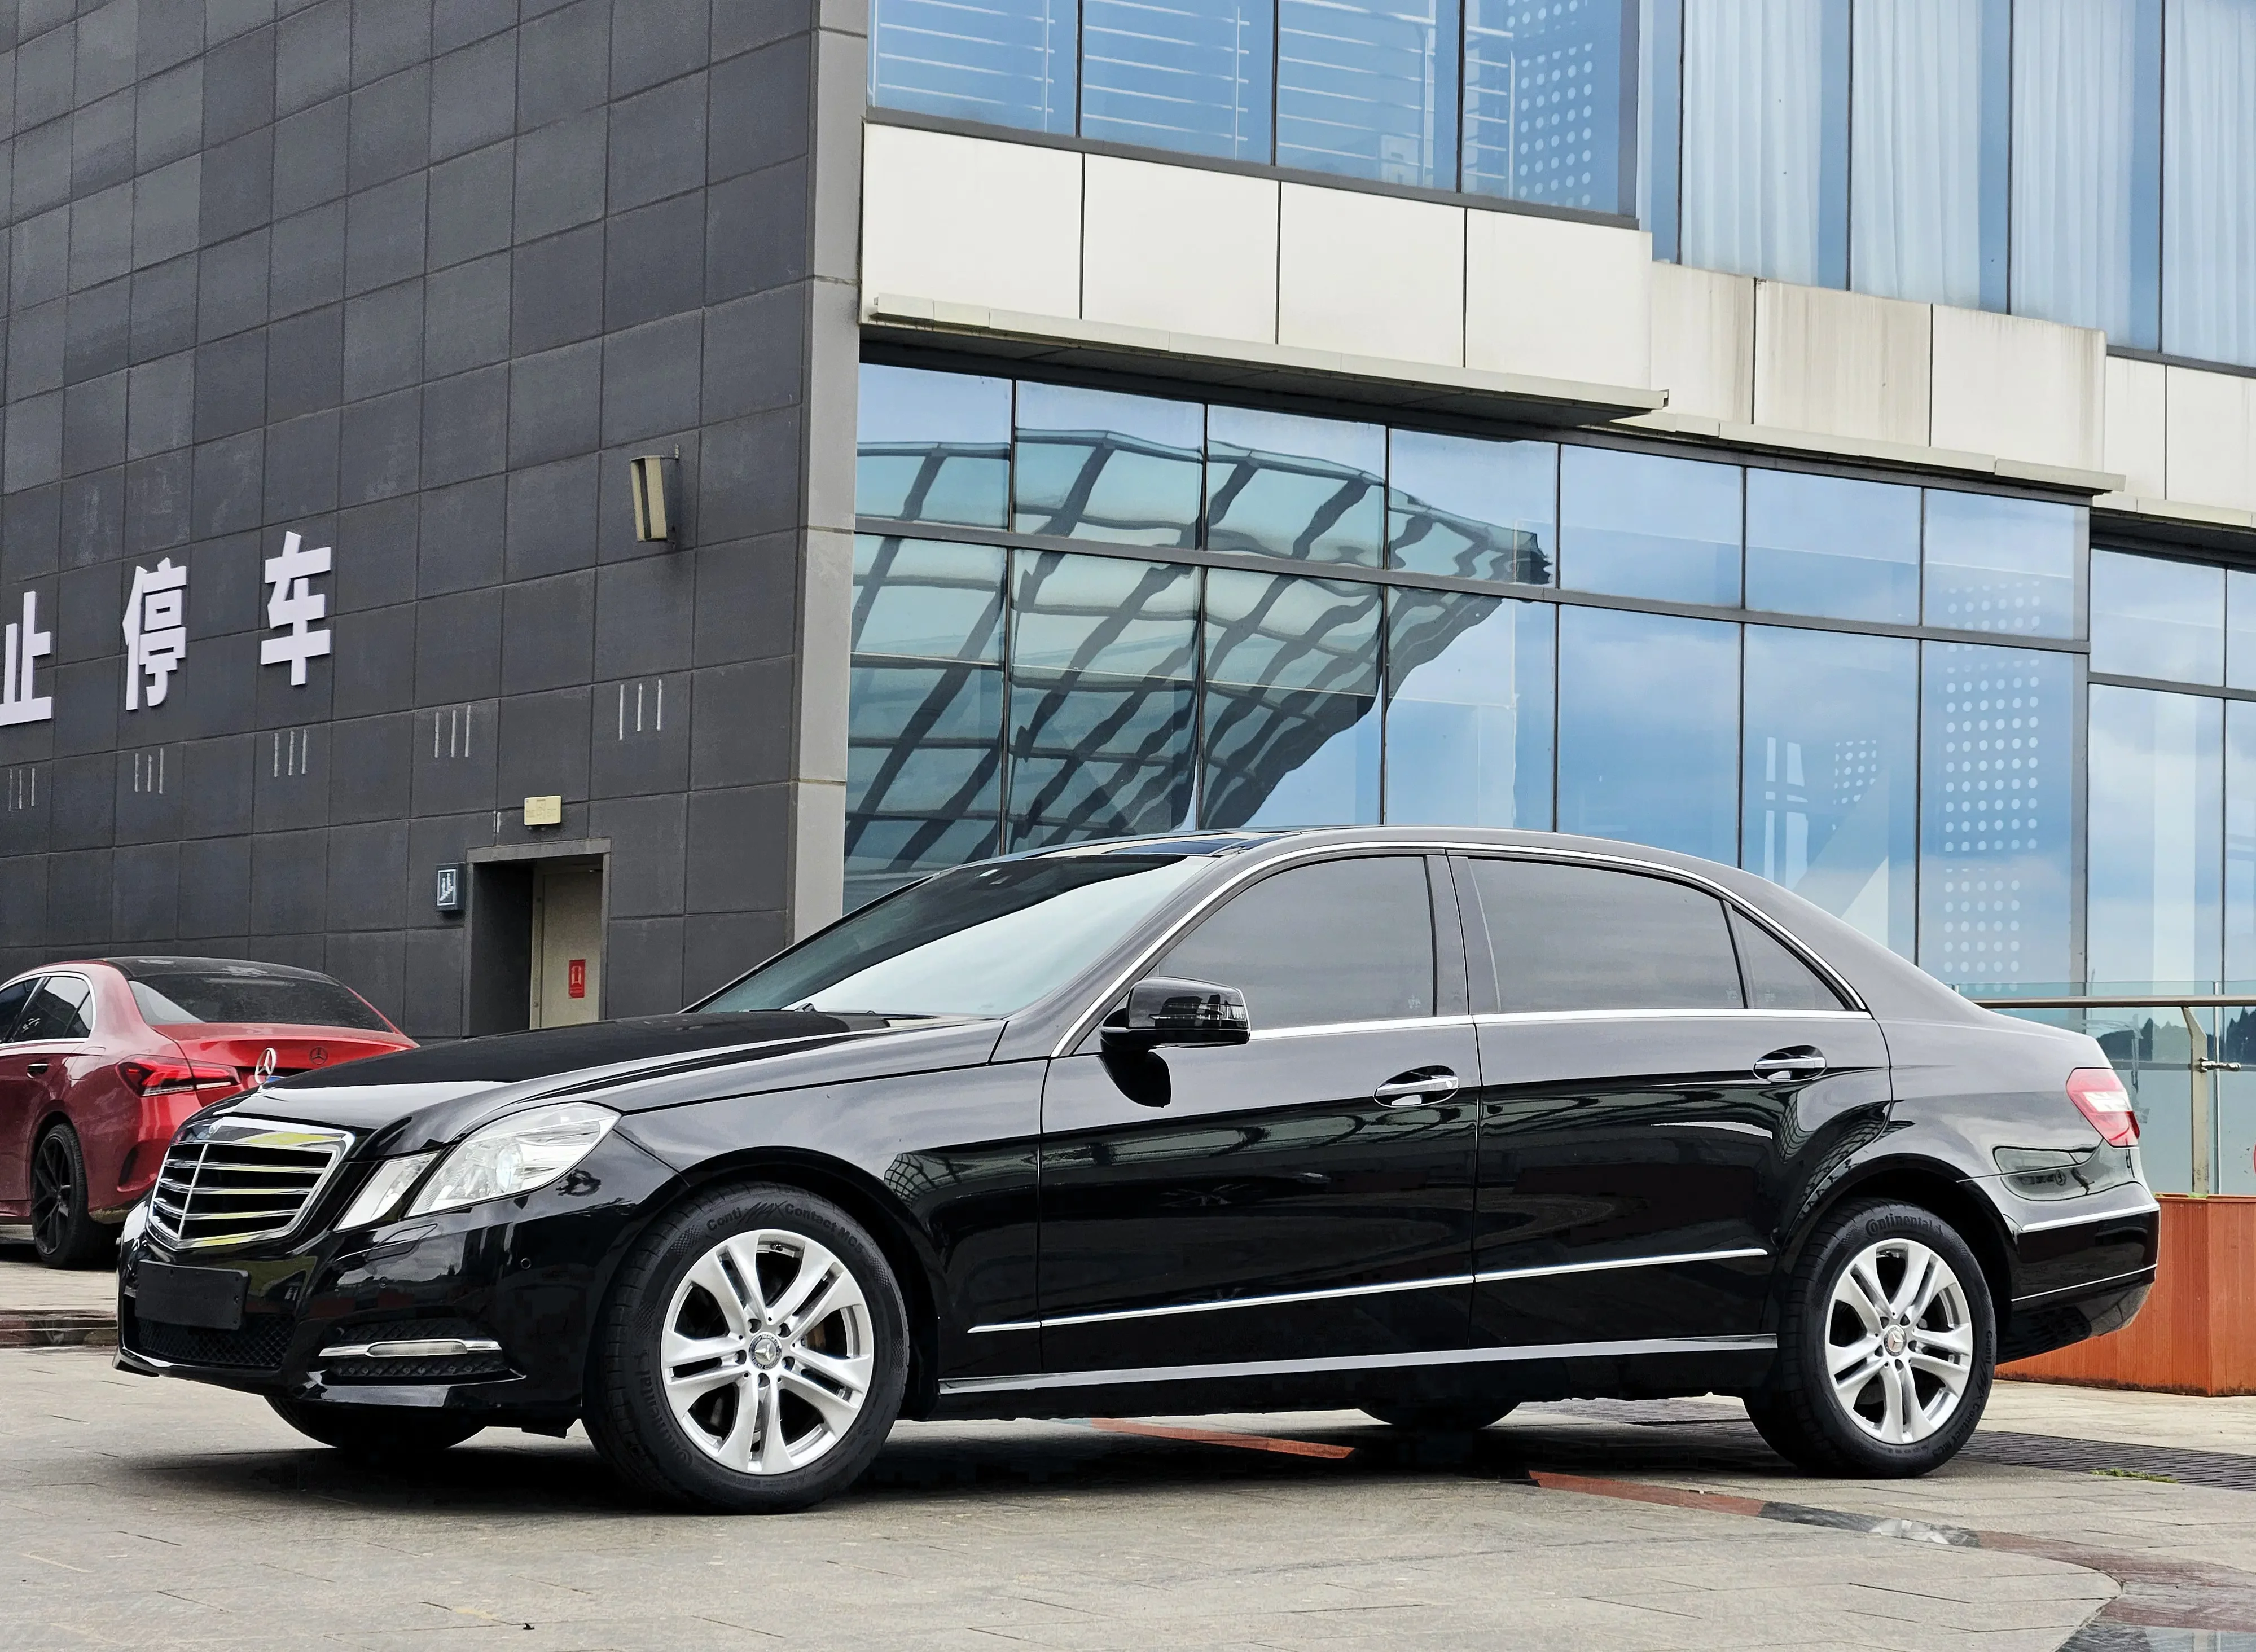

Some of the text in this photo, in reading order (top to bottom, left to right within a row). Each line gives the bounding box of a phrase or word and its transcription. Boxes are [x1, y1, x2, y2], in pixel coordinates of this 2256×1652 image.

[706, 1207, 742, 1231] Conti
[785, 1203, 837, 1233] Contact
[1866, 1213, 1933, 1237] Continental
